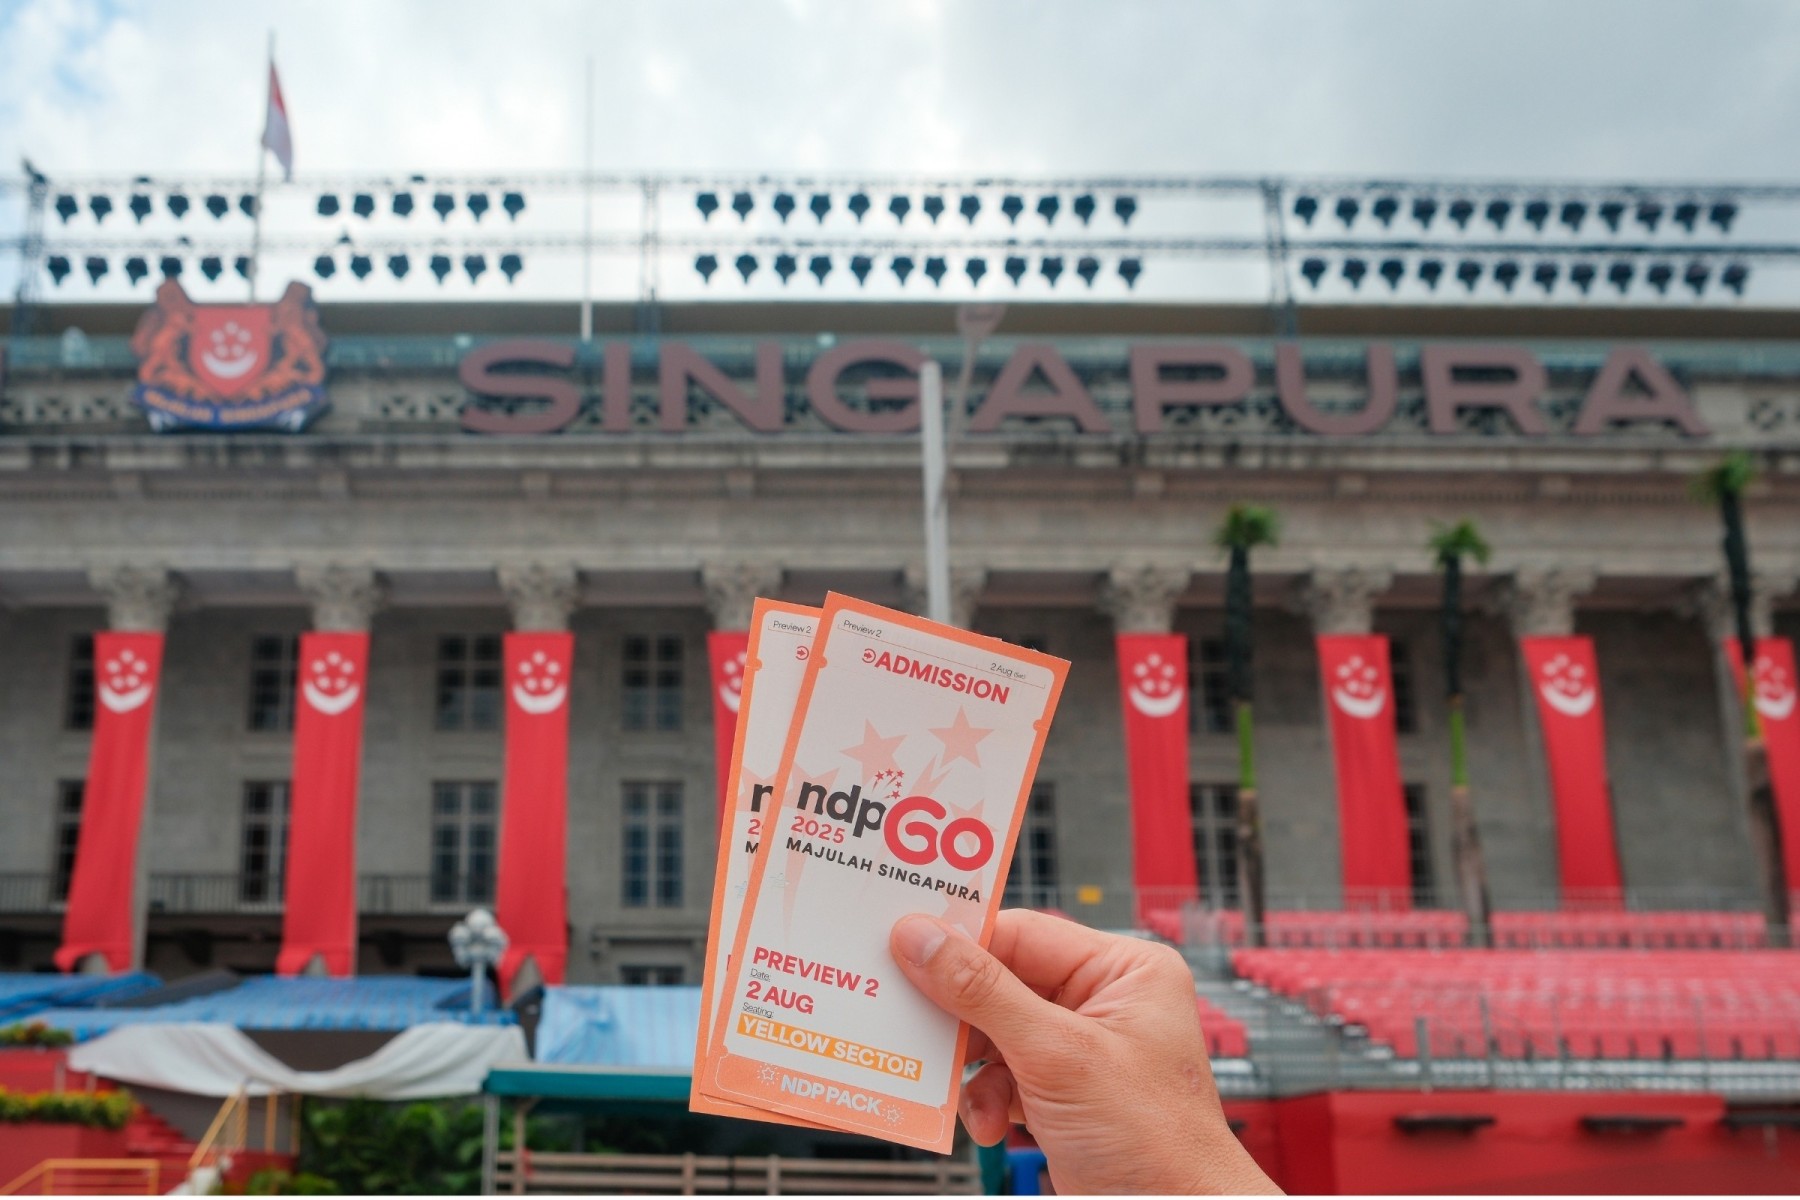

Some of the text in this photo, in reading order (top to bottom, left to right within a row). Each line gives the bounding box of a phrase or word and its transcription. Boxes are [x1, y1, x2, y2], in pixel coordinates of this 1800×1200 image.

[458, 339, 1710, 434] SINGAPURA
[773, 620, 812, 634] Preview 2
[843, 619, 882, 638] Preview 2
[874, 651, 1010, 704] ADMISSION
[990, 662, 997, 671] 2
[996, 664, 1013, 677] Aug
[791, 815, 845, 844] 2025
[786, 837, 981, 903] MAJULAH SINGAPURA
[749, 968, 771, 982] Date:
[752, 946, 862, 992] PREVIEW
[864, 978, 880, 998] 2
[742, 1002, 775, 1018] Seating:
[745, 980, 814, 1015] 2 AUG
[743, 1015, 918, 1078] YELLOW SECTOR
[781, 1074, 883, 1116] NDP PACK
